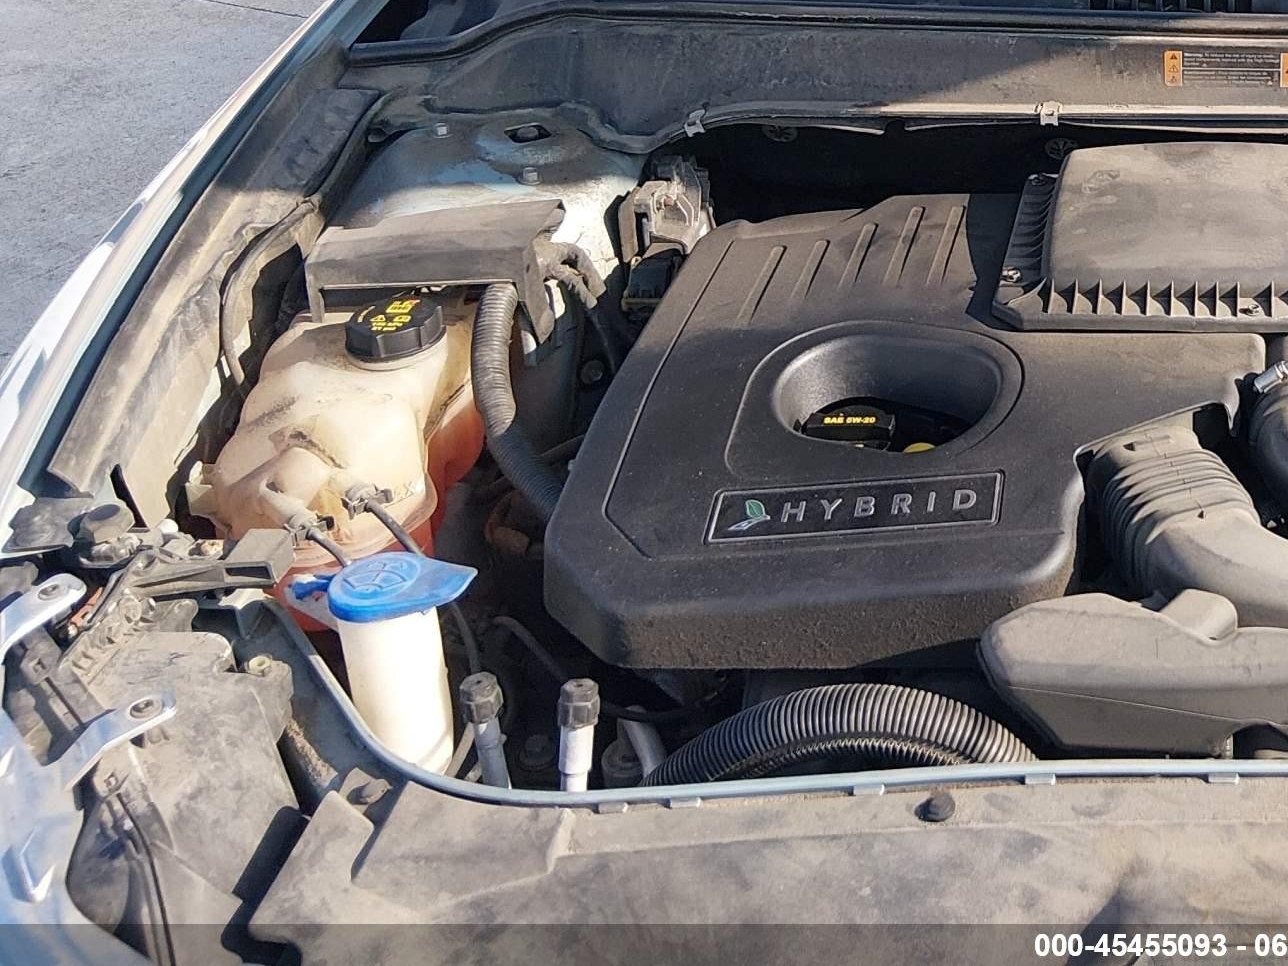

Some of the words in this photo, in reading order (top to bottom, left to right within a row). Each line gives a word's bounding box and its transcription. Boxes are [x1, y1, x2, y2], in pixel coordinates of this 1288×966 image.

[823, 416, 845, 424] SAE
[846, 416, 877, 424] 5W-20
[780, 488, 978, 523] HYBRID
